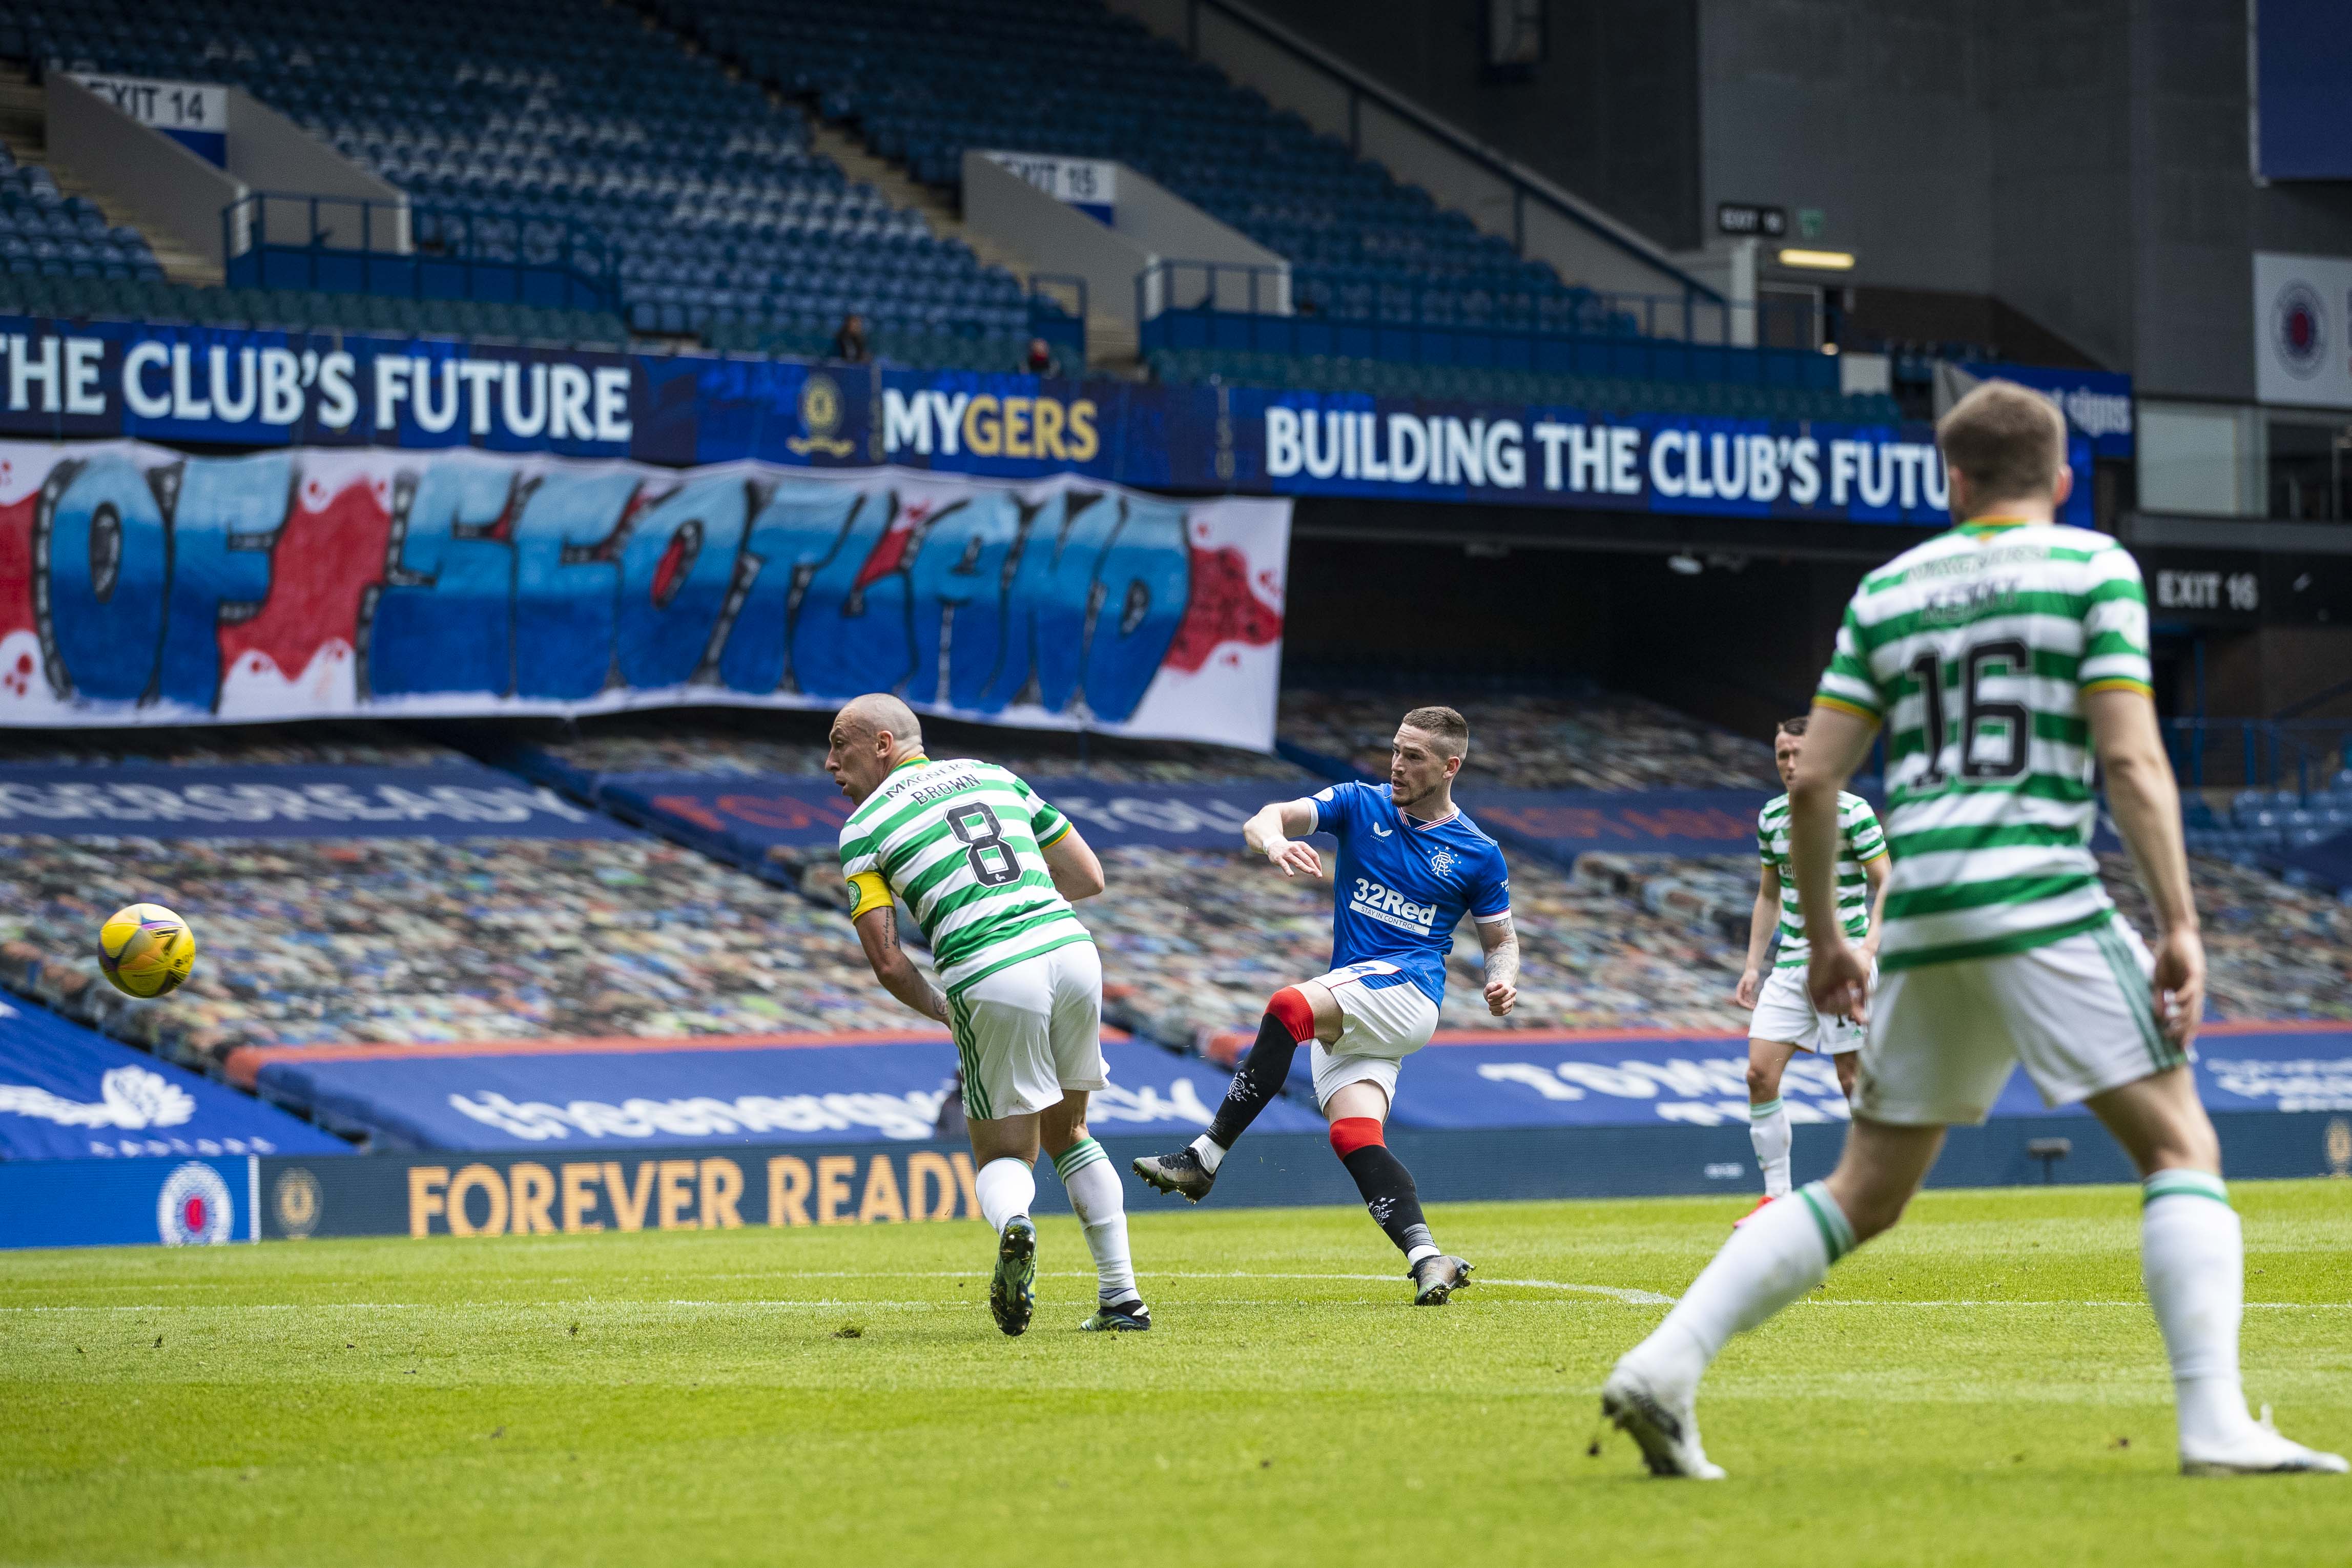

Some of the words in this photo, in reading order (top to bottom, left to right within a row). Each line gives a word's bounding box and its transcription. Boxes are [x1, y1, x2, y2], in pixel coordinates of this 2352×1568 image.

[88, 80, 159, 120] XIT
[170, 89, 203, 122] 14
[0, 333, 107, 415] HE
[122, 341, 358, 429] CLUB'S
[374, 354, 633, 442] FUTURE
[882, 387, 1100, 463] MYGERS
[1265, 406, 1526, 489] BUILDING
[1532, 421, 1641, 495] THE
[1648, 429, 1822, 505] CLUB'S
[1829, 439, 1951, 511] FUTU
[32, 453, 302, 716] OF
[2155, 569, 2222, 609] EXIT
[1907, 638, 2031, 794] 16
[910, 774, 982, 806] BROWN
[944, 800, 1024, 889] 8
[1353, 878, 1438, 926] 32Red
[1360, 906, 1376, 917] STAY
[1384, 915, 1416, 932] CONTROL
[408, 1157, 746, 1239] FOREVER
[767, 1150, 985, 1225] READY
